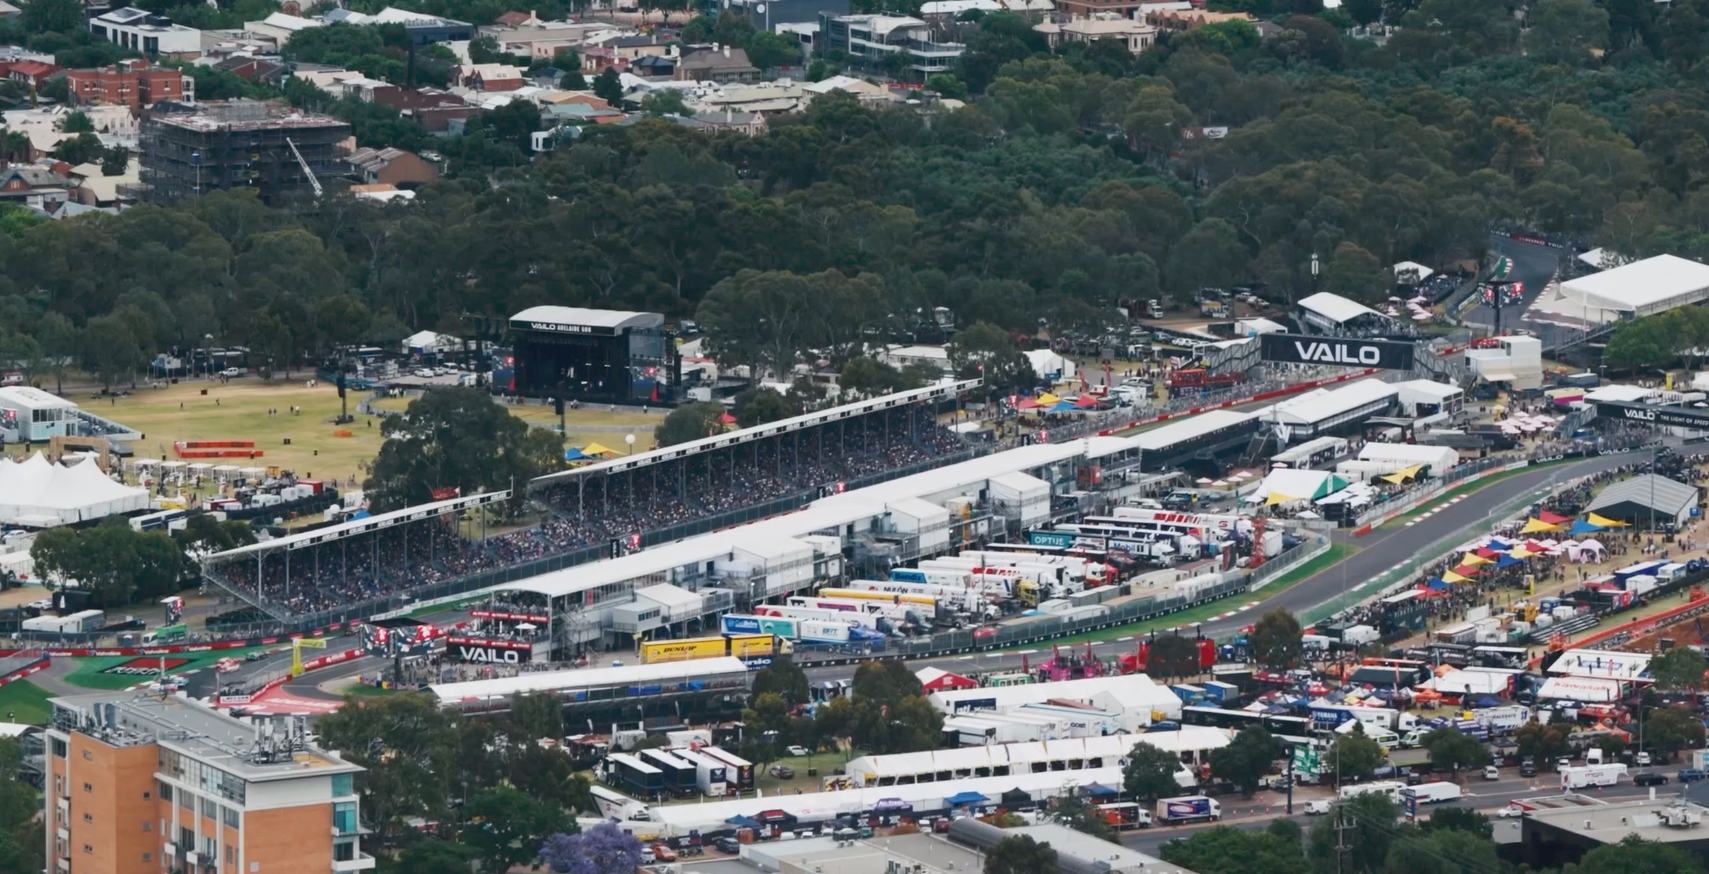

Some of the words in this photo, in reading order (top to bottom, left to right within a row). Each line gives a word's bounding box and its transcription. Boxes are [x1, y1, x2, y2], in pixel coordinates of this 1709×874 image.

[531, 322, 556, 330] VAILO
[1294, 341, 1380, 364] VAILO
[1624, 408, 1656, 420] VAILO
[1536, 454, 1564, 463] VAILO
[460, 646, 518, 663] VAILO
